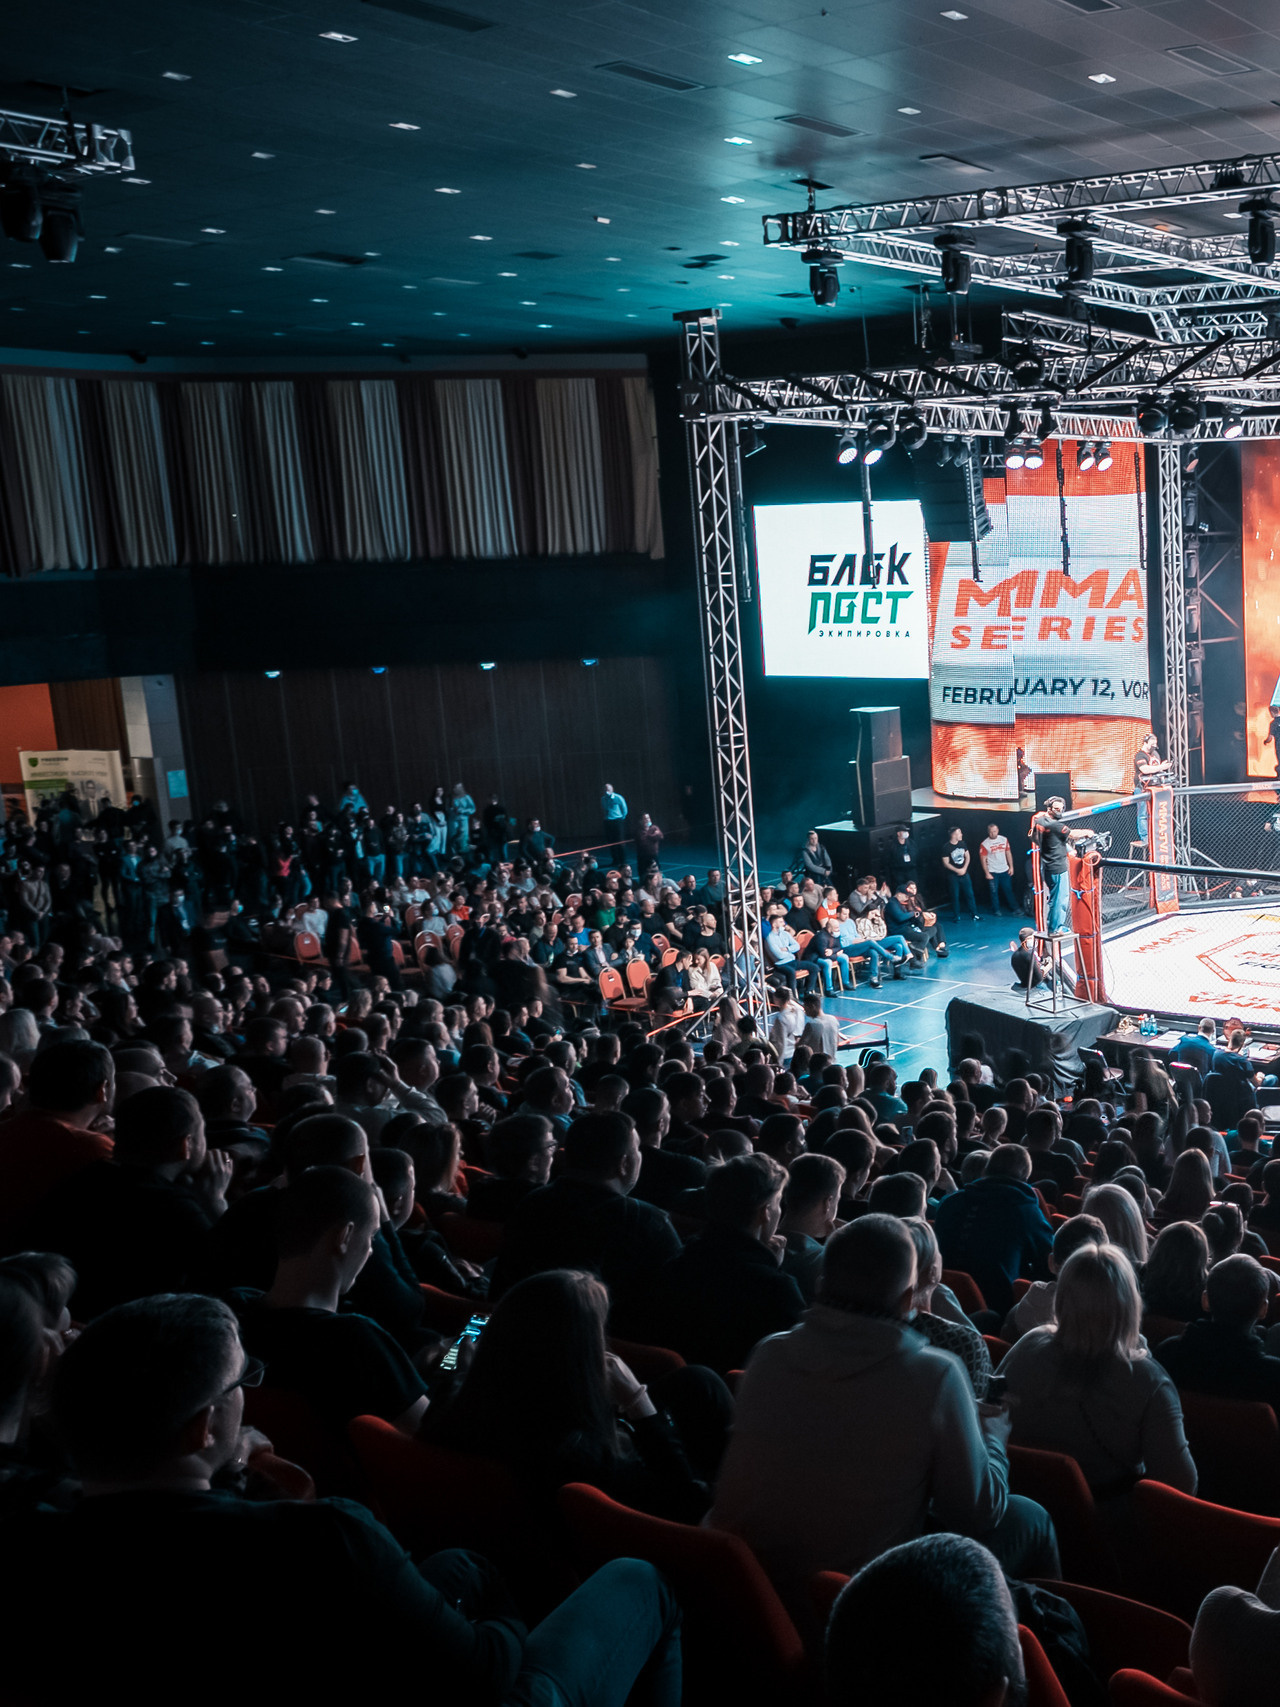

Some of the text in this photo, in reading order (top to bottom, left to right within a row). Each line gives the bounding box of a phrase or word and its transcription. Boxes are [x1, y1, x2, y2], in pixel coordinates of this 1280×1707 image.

[954, 569, 1145, 617] MMA
[807, 591, 914, 635] ПОСТ
[819, 630, 911, 638] ЭКИПИРОВКА
[950, 616, 1145, 650] SERIES
[1091, 679, 1116, 700] 12,
